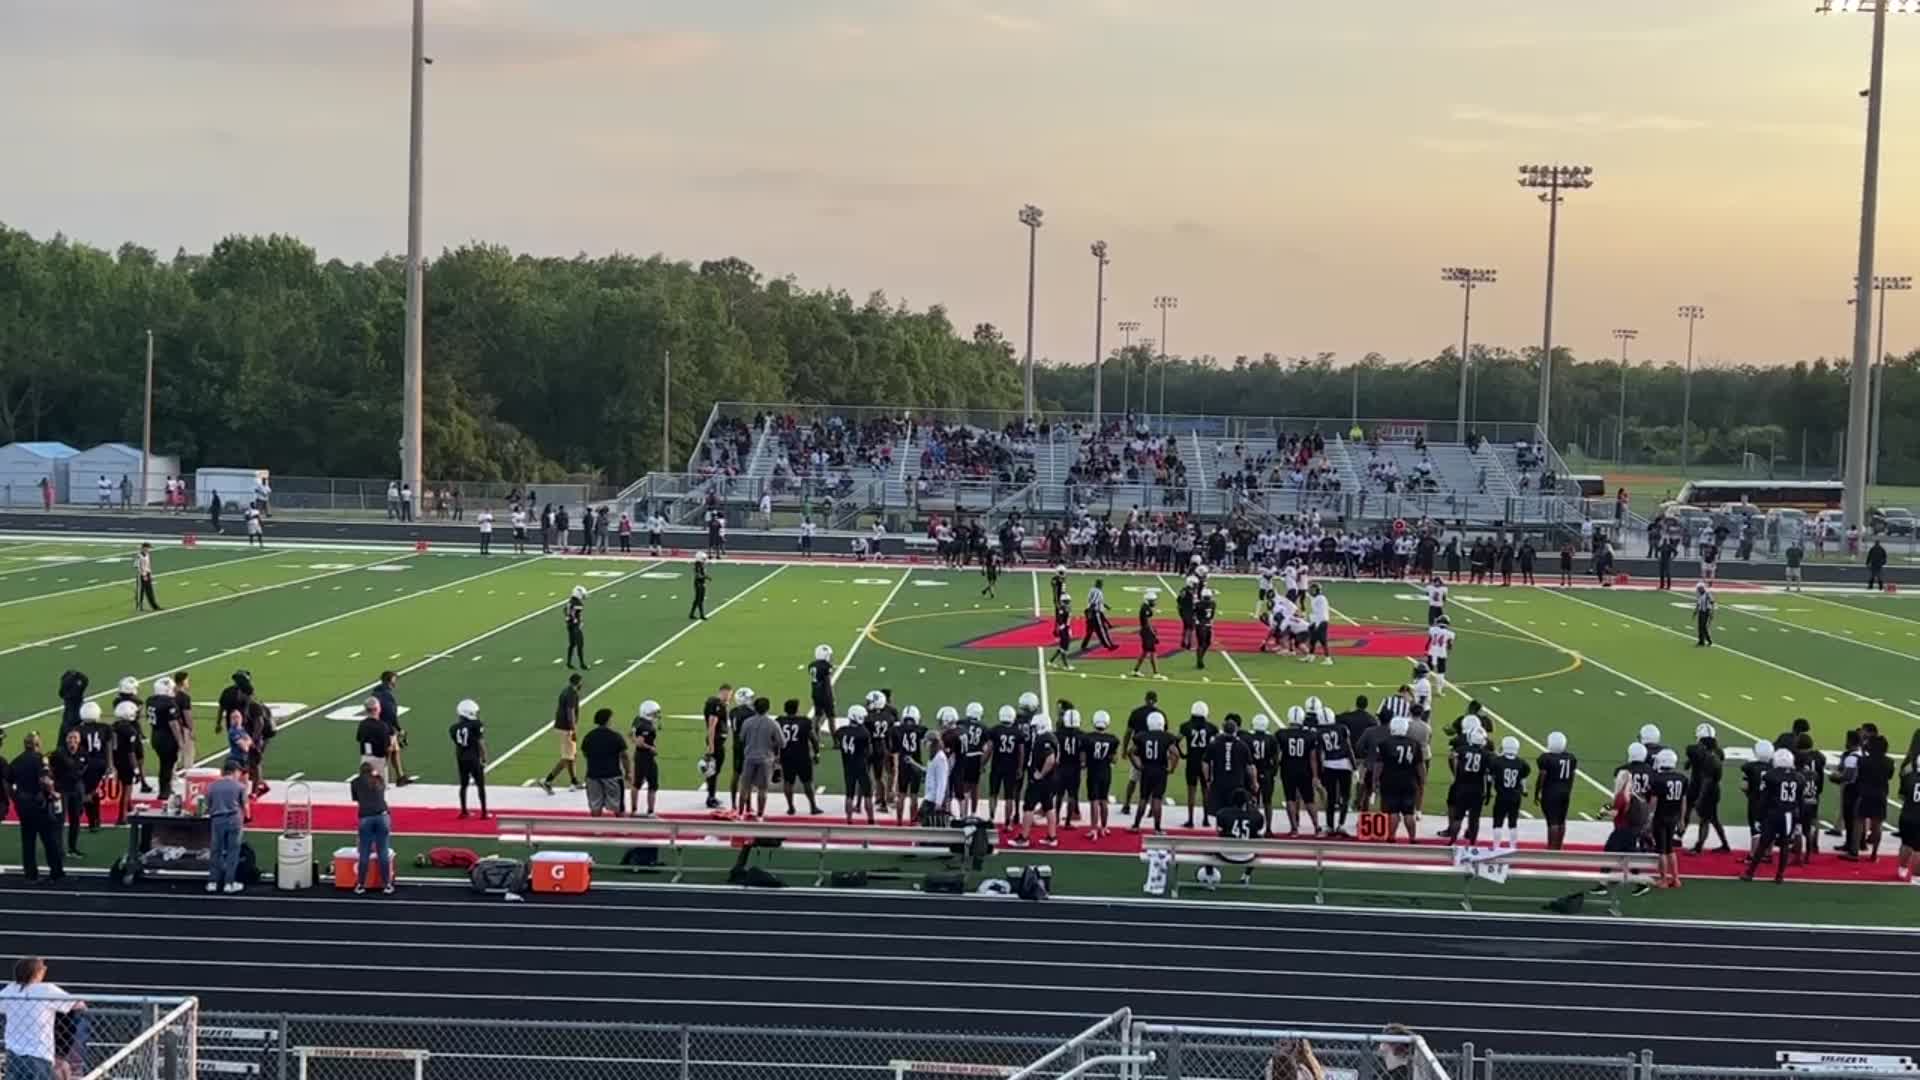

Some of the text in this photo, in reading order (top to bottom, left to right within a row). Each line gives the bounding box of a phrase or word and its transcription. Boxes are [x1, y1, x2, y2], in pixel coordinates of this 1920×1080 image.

[783, 724, 799, 742] 52
[872, 720, 888, 738] 32
[1190, 728, 1207, 748] 23
[87, 731, 102, 752] 14
[842, 735, 855, 755] 44
[902, 732, 917, 752] 43
[999, 734, 1016, 753] 35
[1064, 736, 1077, 756] 41
[1094, 741, 1110, 760] 87
[1145, 740, 1159, 760] 61
[1252, 740, 1265, 759] 31
[1288, 738, 1305, 757] 60
[1322, 731, 1341, 751] 82
[1396, 745, 1413, 764] 74
[1465, 753, 1482, 772] 28
[1559, 759, 1571, 779] 71
[1633, 773, 1650, 792] 62
[1666, 780, 1683, 801] 30
[1780, 781, 1797, 801] 63
[1231, 819, 1250, 840] 45
[1361, 813, 1386, 837] 50
[551, 865, 565, 880] G
